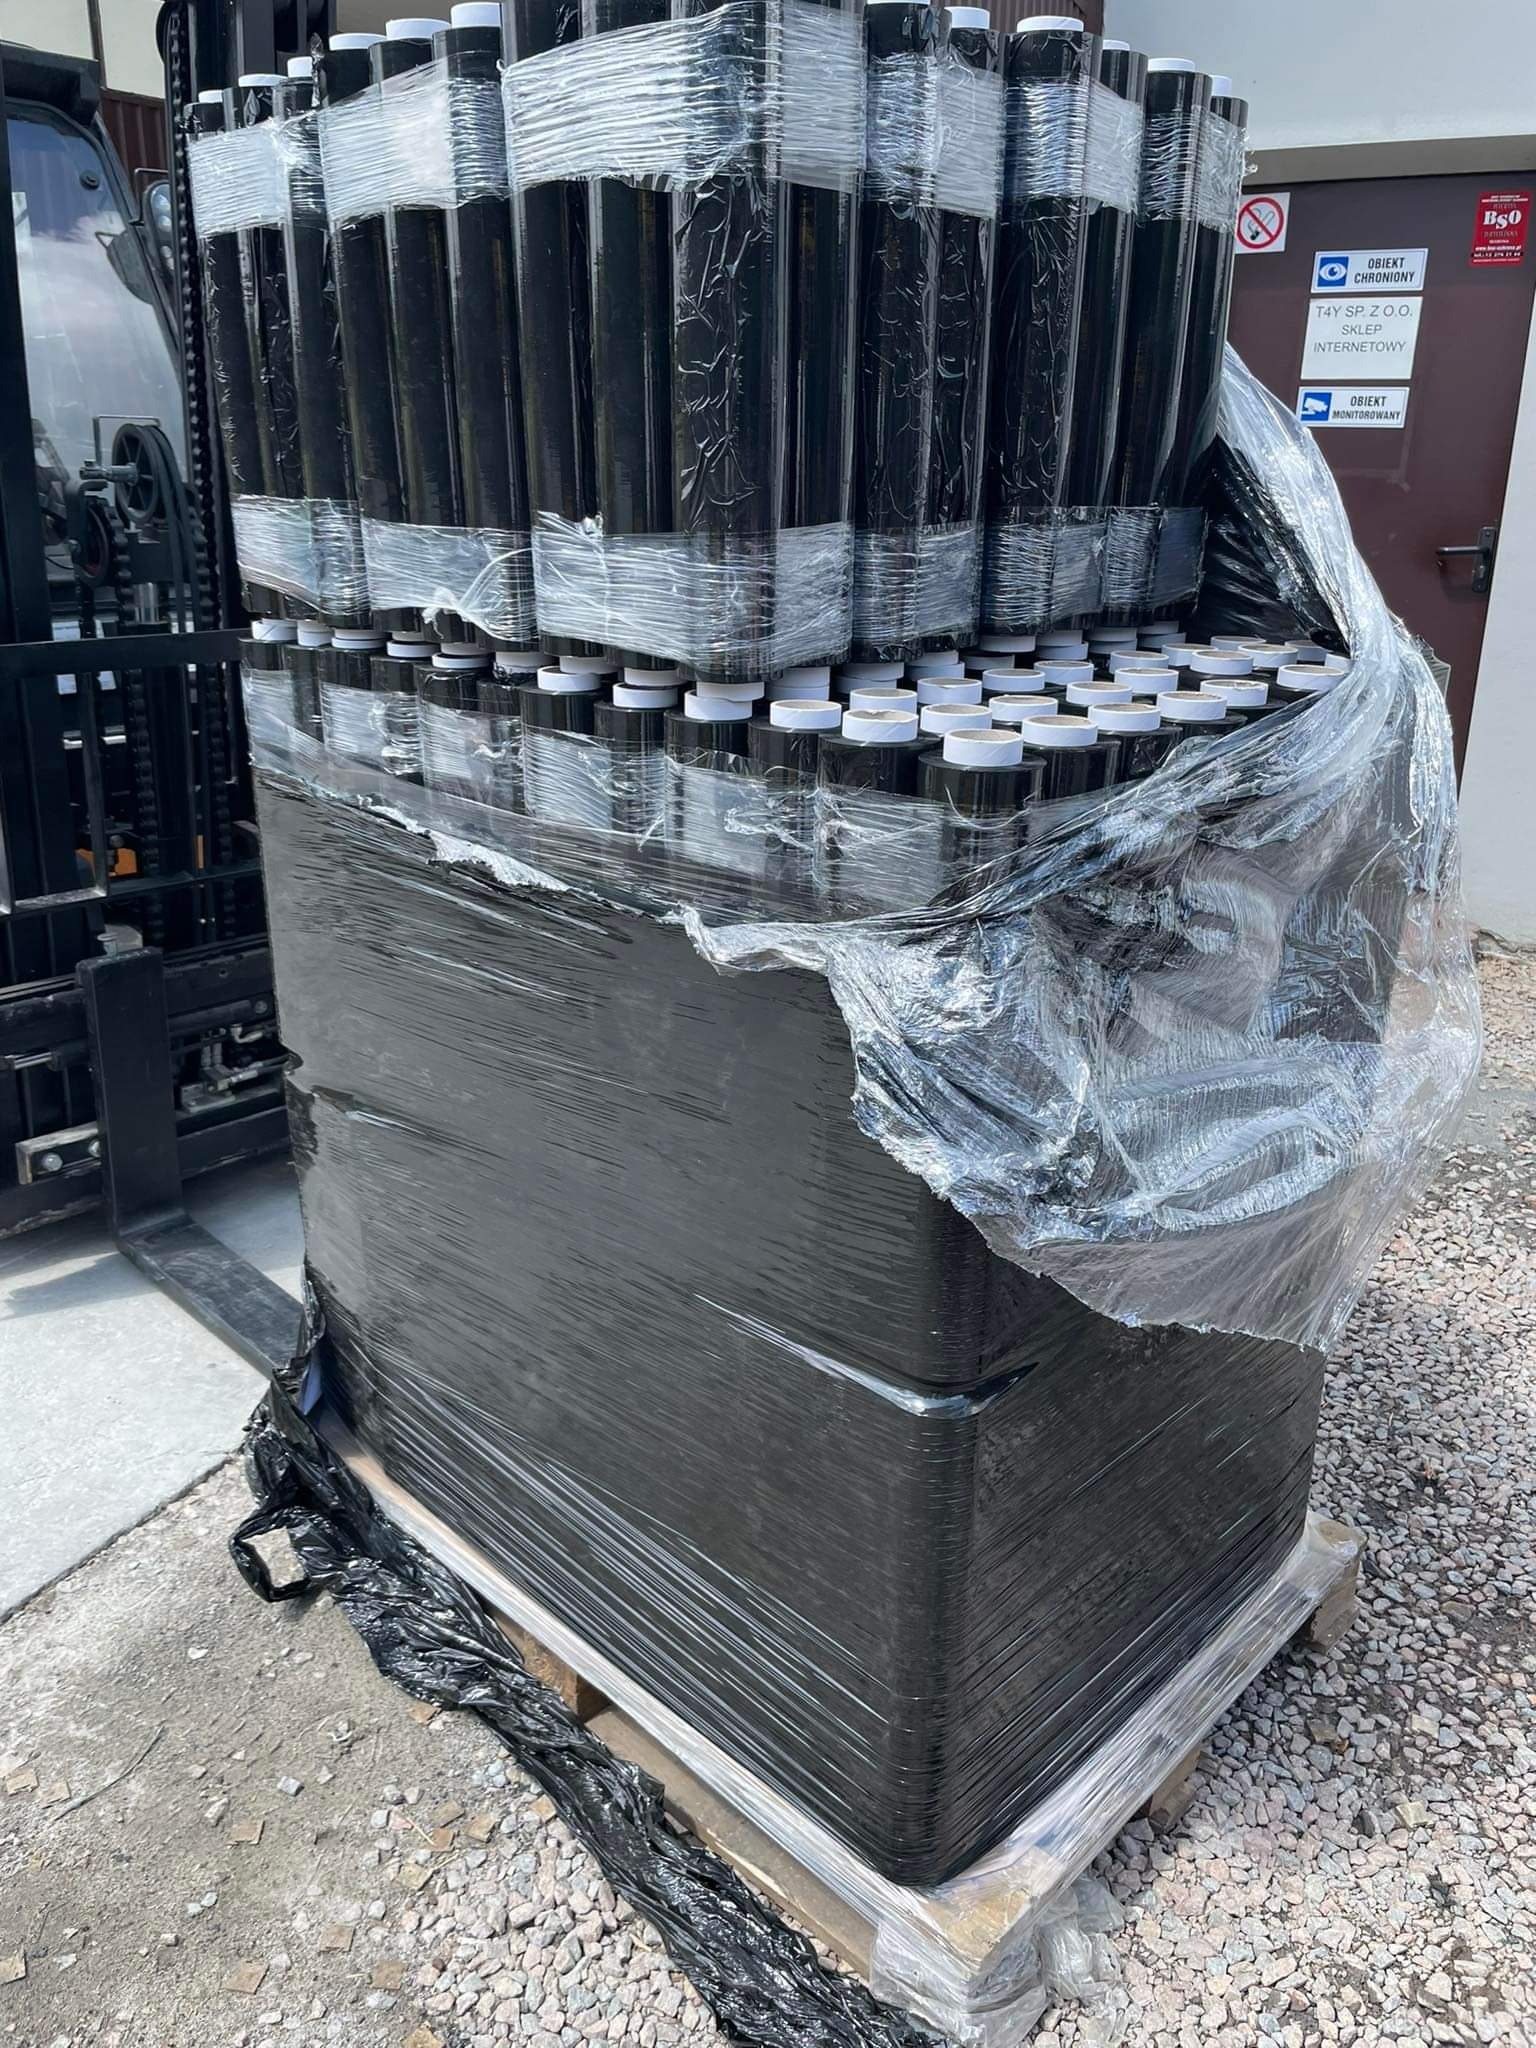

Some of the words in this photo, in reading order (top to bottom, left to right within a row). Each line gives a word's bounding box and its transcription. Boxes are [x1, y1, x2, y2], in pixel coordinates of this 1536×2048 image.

[1367, 257, 1405, 270] OBIEKT
[1354, 271, 1415, 284] CHRONIONY
[1315, 305, 1342, 318] T4Y
[1345, 305, 1366, 318] SP.
[1369, 305, 1380, 317] Z
[1383, 304, 1413, 317] O.O.
[1341, 324, 1382, 336] SKLEP
[1313, 341, 1406, 353] INTERNETOWY
[1350, 396, 1387, 407] OBIEKT
[1331, 410, 1401, 420] MONITOROWANY
